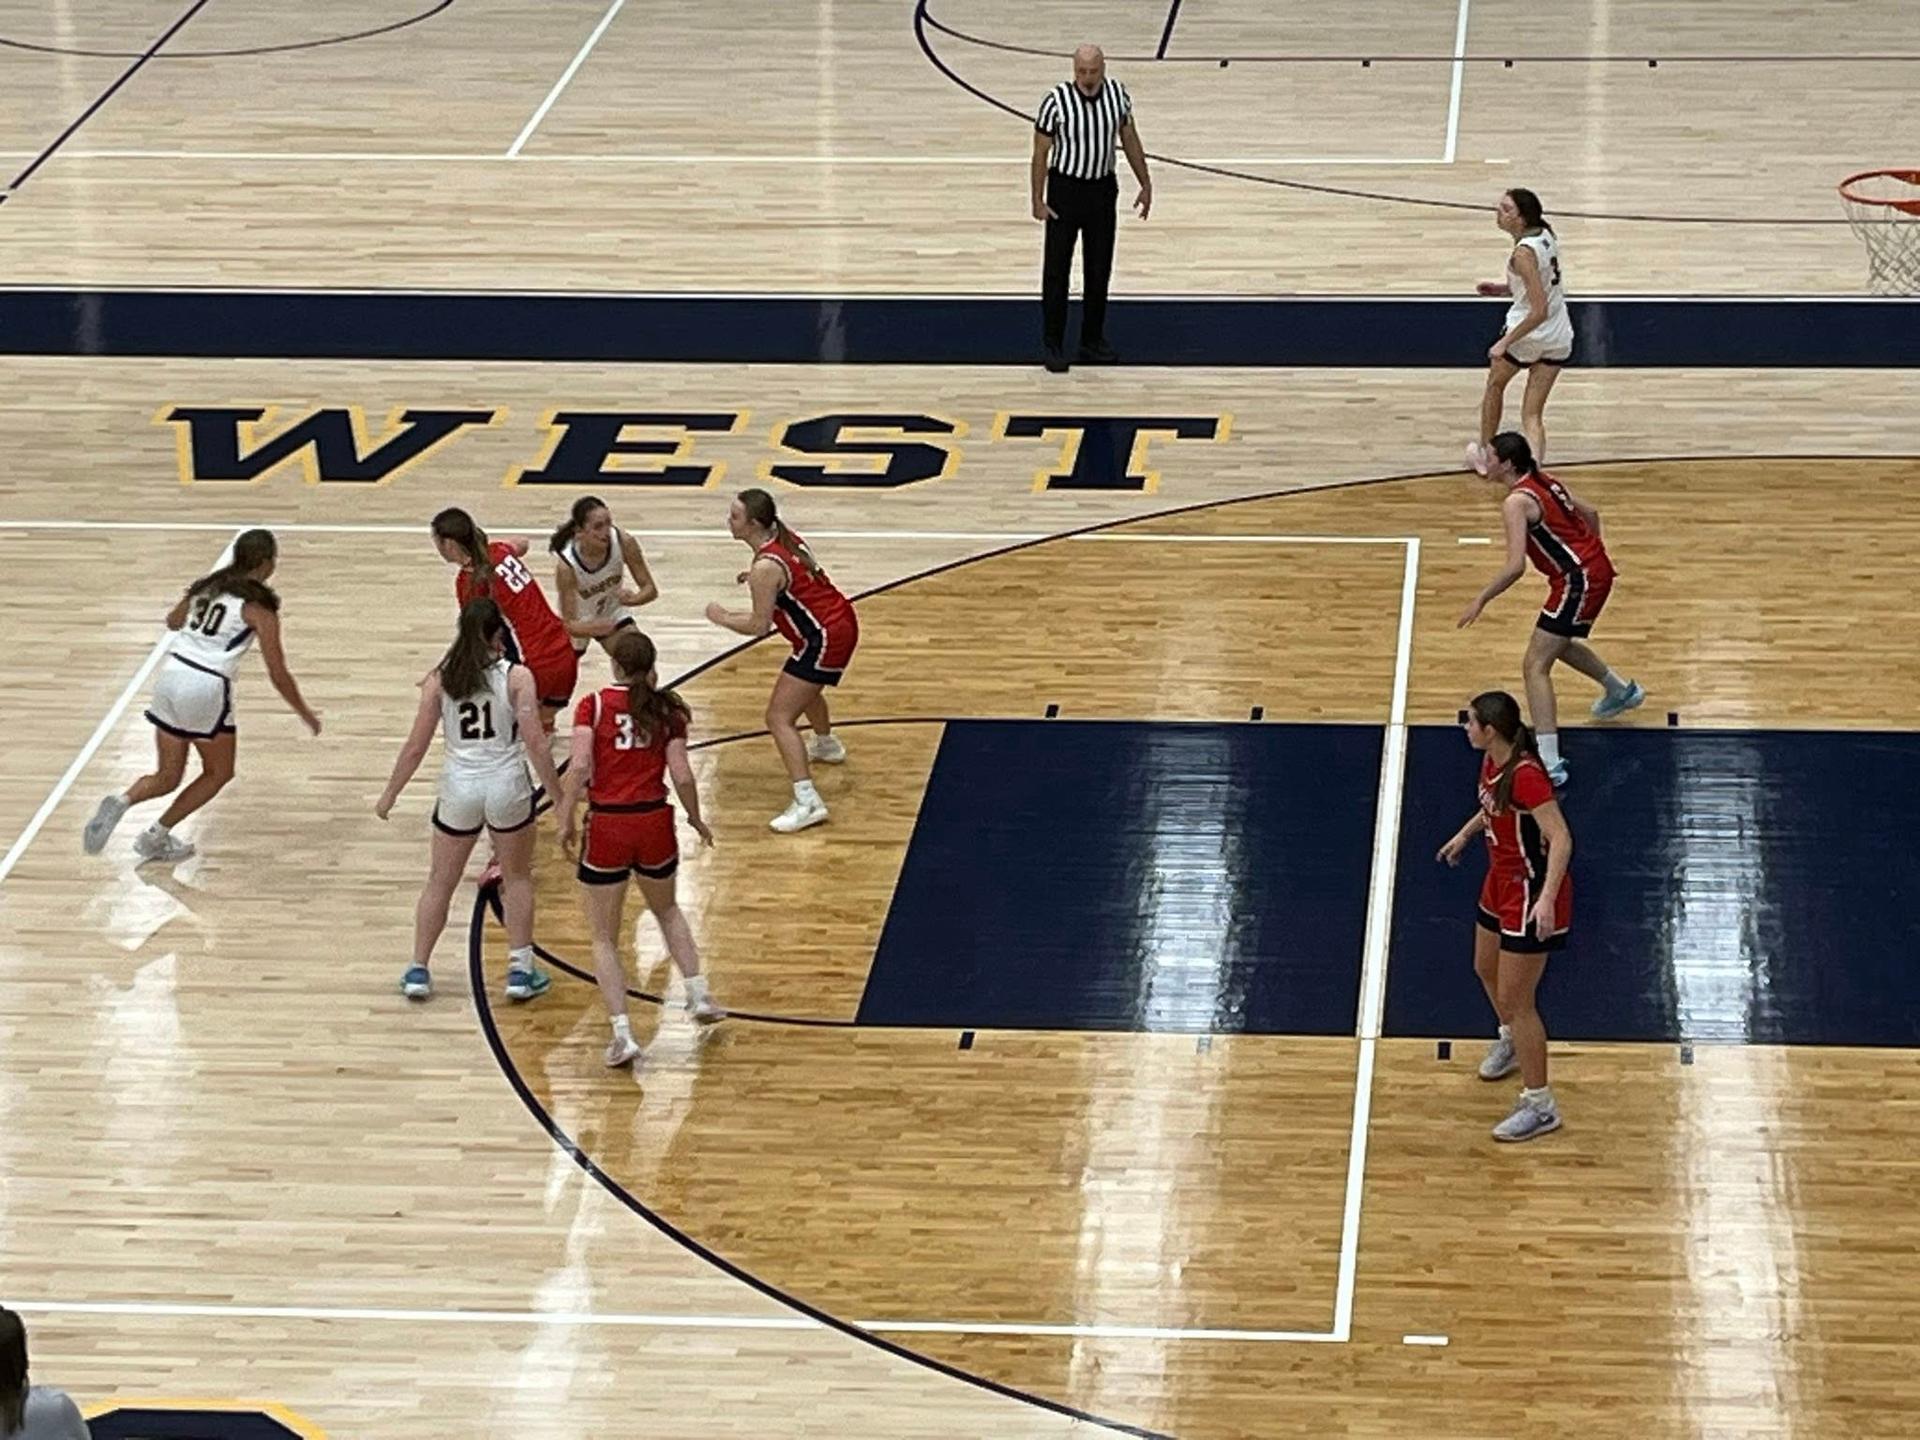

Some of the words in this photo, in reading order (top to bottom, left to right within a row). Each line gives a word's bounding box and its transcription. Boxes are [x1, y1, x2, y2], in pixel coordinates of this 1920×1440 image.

[160, 407, 1225, 491] WEST
[495, 554, 532, 594] 22
[190, 597, 227, 637] 30
[458, 701, 496, 740] 21
